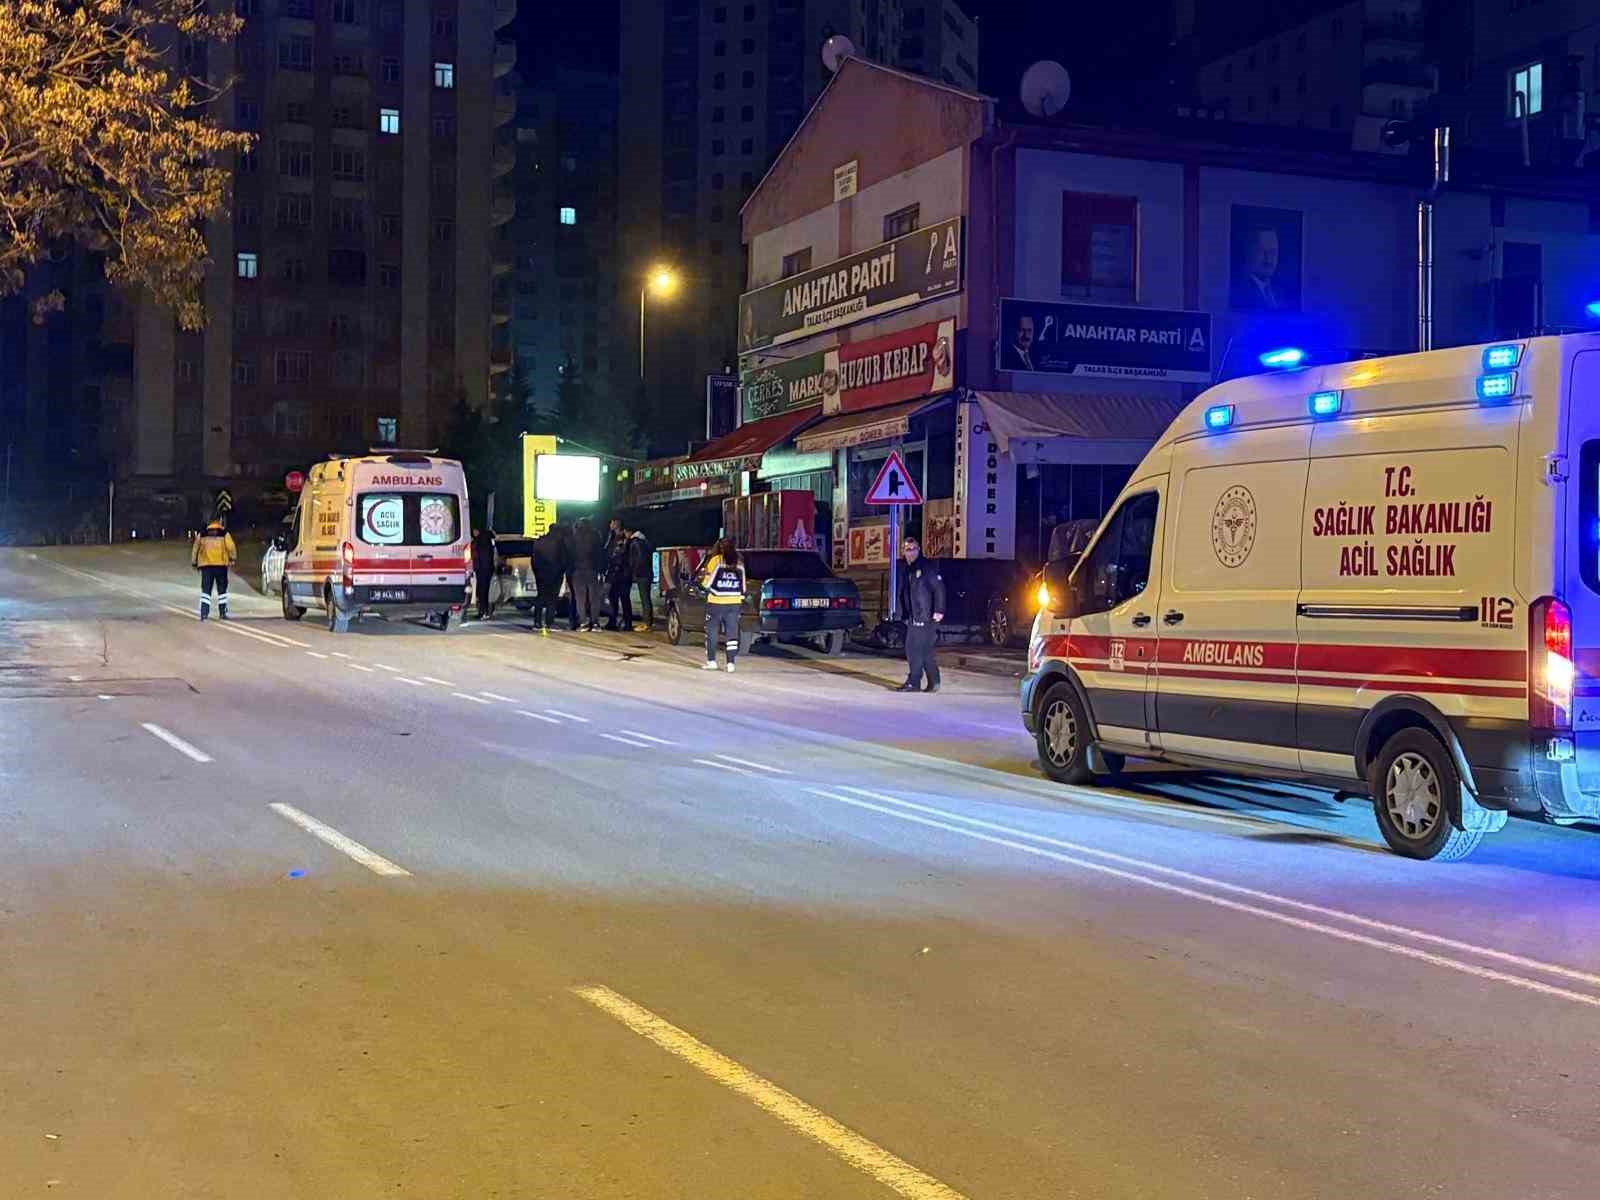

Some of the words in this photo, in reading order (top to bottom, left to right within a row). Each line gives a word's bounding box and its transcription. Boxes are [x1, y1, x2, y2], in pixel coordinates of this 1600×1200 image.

[944, 226, 957, 259] A
[782, 269, 847, 317] ANAHTAR
[851, 244, 896, 295] PARTİ
[1064, 323, 1136, 343] ANAHTAR
[1140, 327, 1181, 345] PARTİ
[1190, 327, 1205, 346] A
[840, 354, 881, 390] HUZUR
[883, 342, 928, 380] KEBAP
[789, 374, 824, 402] MARK
[371, 475, 443, 486] AMBULANS
[986, 442, 998, 514] DÖNER
[1384, 466, 1416, 497] T.C.
[1313, 501, 1376, 536] SAĞLIK
[1385, 494, 1493, 535] BAKANLIĞI
[1339, 540, 1379, 576] ACİL
[1386, 538, 1456, 576] SAĞLIK
[1481, 596, 1515, 624] 112
[1110, 642, 1124, 658] 112
[1183, 641, 1264, 666] AMBULANS
